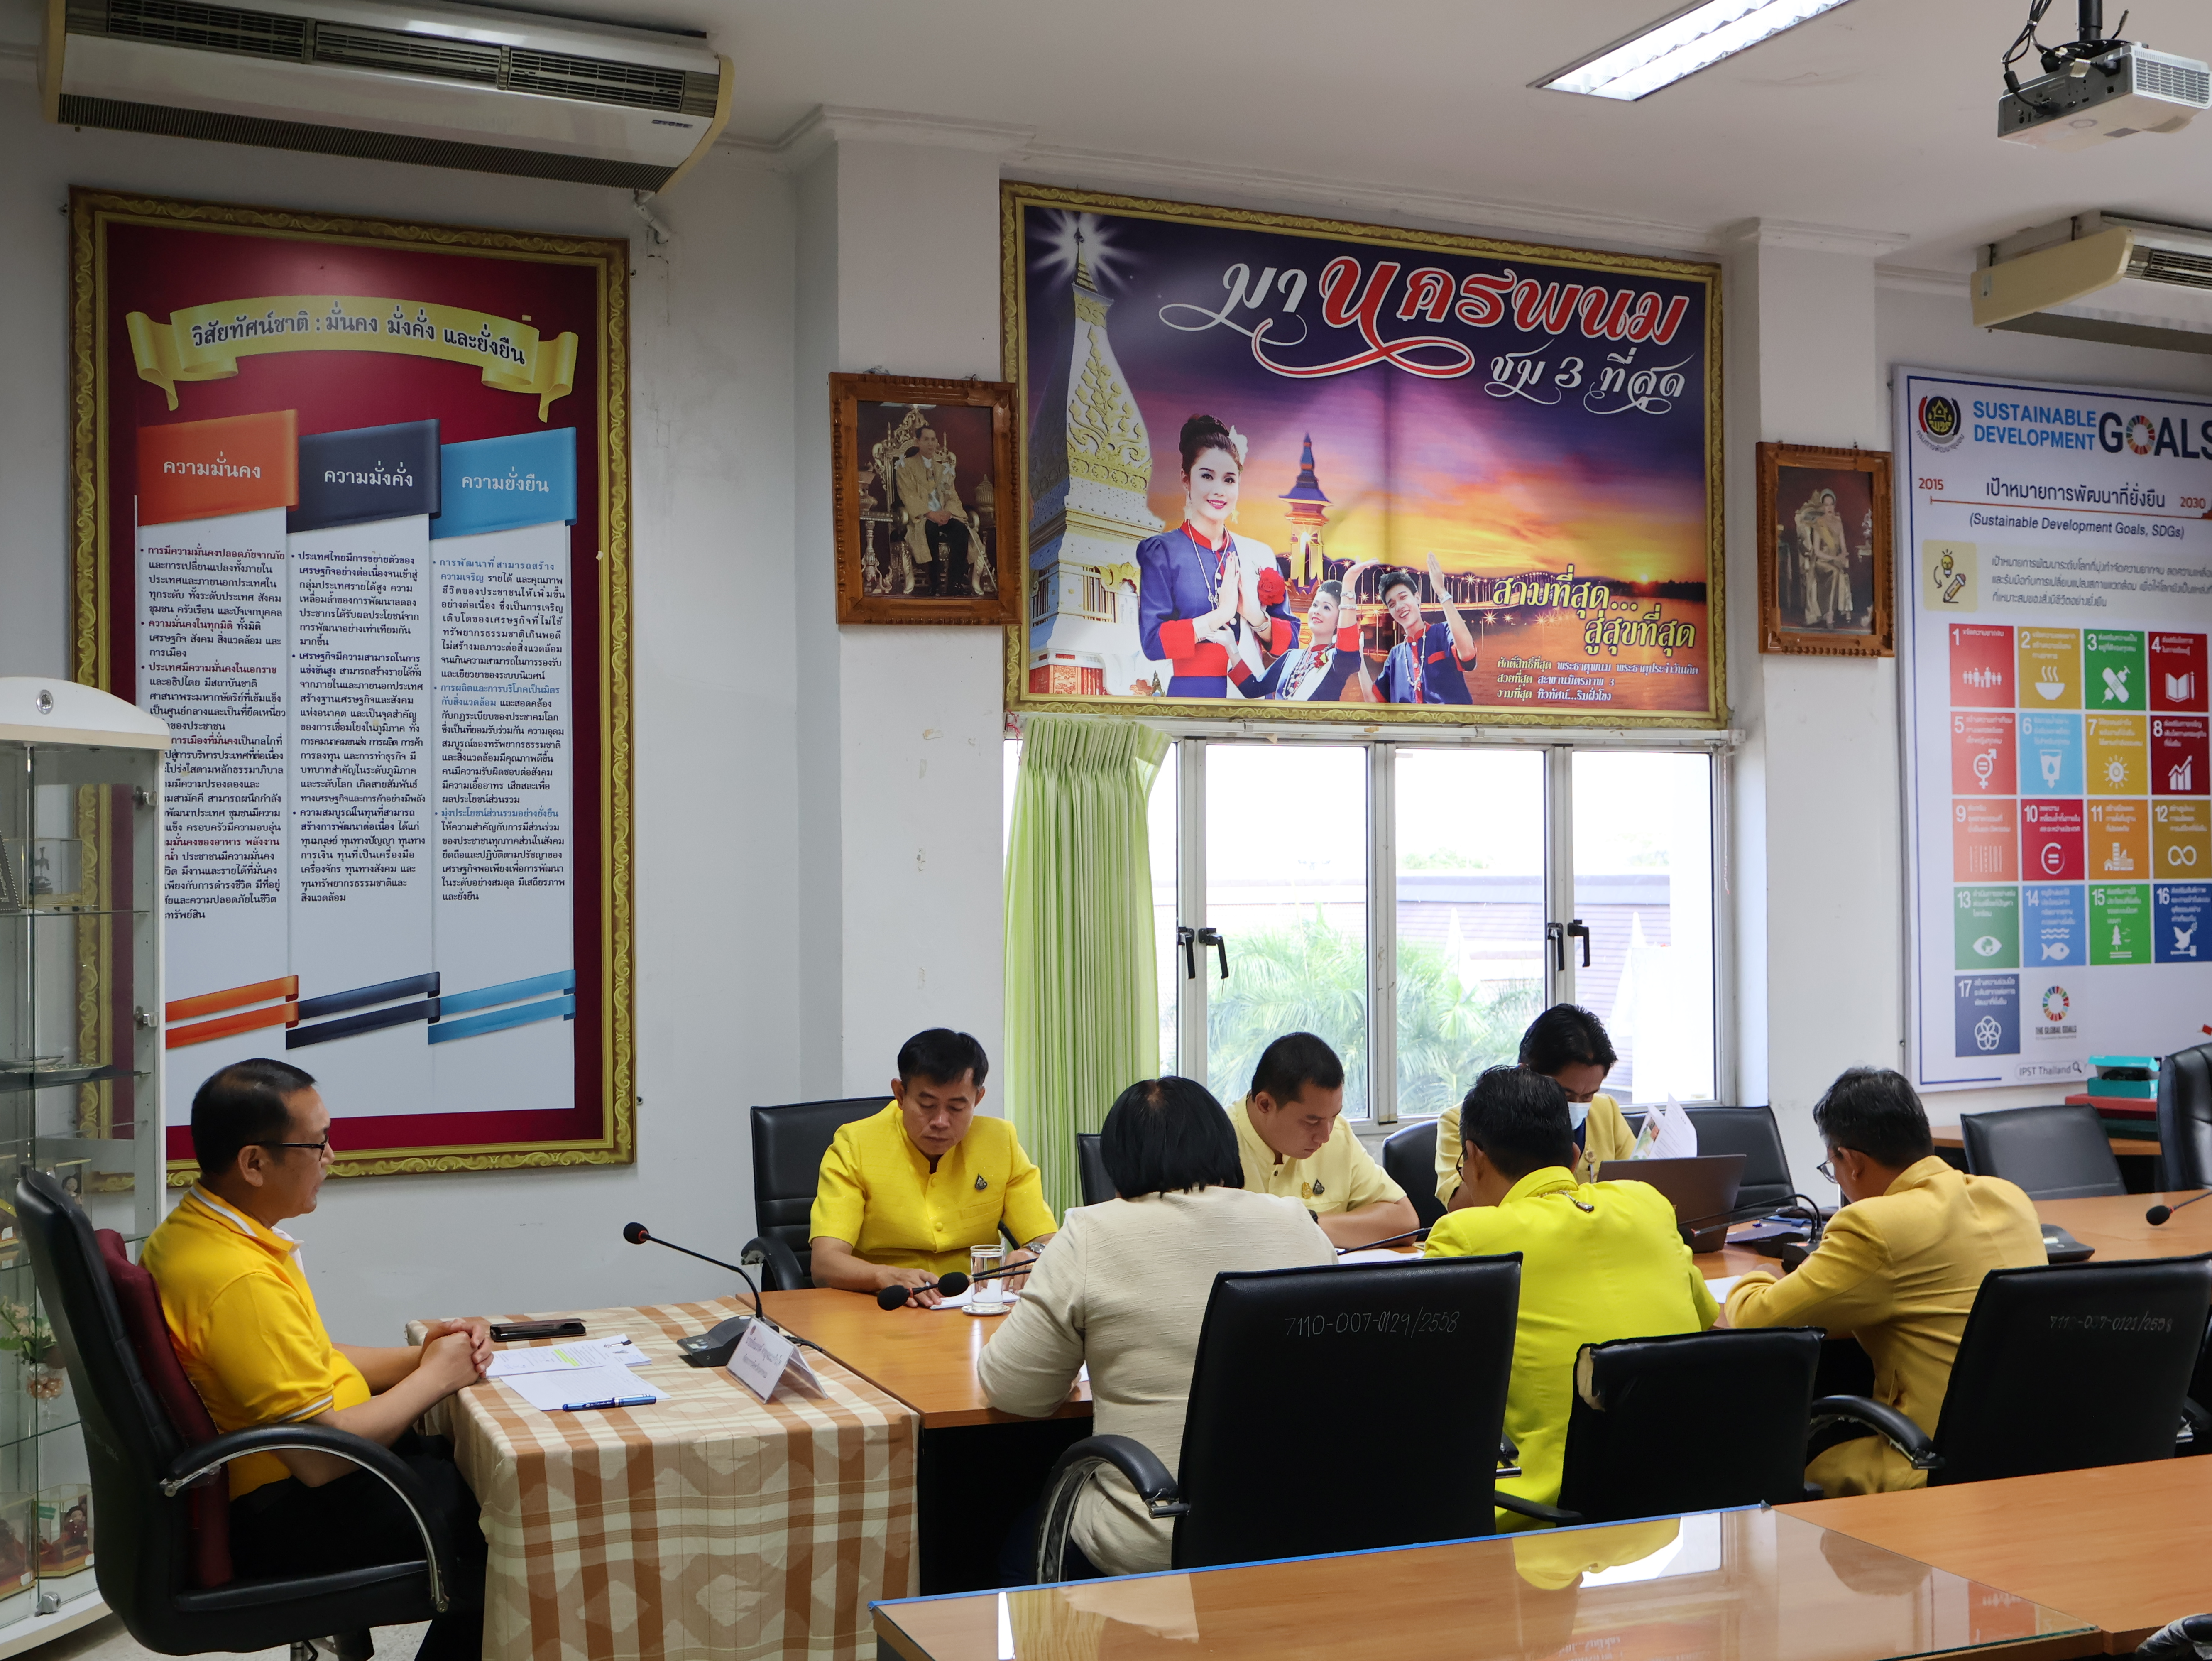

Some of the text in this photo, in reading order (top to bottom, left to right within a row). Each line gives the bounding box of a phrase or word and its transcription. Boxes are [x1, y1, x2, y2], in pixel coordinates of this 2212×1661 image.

[192, 309, 309, 348] วิสัยทัศน์ชาติ
[325, 301, 378, 333] มั่นคง
[387, 306, 436, 342] มั่งคั่ง
[443, 323, 525, 365] และยั่งยืน
[1556, 357, 1583, 388] 3
[1973, 401, 2096, 427] SUSTAINABLE
[1974, 425, 2095, 451] DEVELOPMENT
[163, 451, 261, 479] ความมั่นคง
[324, 460, 413, 487] ความมั่งคั่ง
[461, 466, 549, 493] ความยั่งยืน
[1919, 478, 1944, 490] 2015
[1987, 478, 2165, 508] เป้าหมายการพัฒนาที่ยั่งยืน
[2180, 497, 2206, 509] 2030
[1970, 513, 2184, 539] (Sustainable Development Goals, SDGs)
[441, 572, 563, 587] ความเจริญ รายได้ และคุณภาพ
[149, 589, 184, 601] ทุกระดับ
[258, 593, 281, 603] สังคม
[149, 605, 174, 616] ชุมชน
[177, 604, 214, 615] ครัวเรือน
[236, 617, 261, 630] ทั้งมิติ
[1584, 604, 1696, 657] สู่สุขที่สุด
[149, 632, 187, 645] เศรษฐกิจ
[190, 633, 214, 643] สังคม
[217, 634, 262, 645] สิ่งแวดล้อม
[299, 633, 330, 646] มากขึ้น
[1953, 629, 1960, 646] 1
[2021, 631, 2031, 649] 2
[2087, 634, 2097, 651] 3
[2151, 637, 2161, 653] 4
[149, 647, 187, 657] การเมือง
[300, 664, 336, 678] แข่งขันสูง
[1497, 655, 1552, 672] ศักดิ์สิทธิ์ที่สุด
[1556, 661, 1611, 674] พระธาตุพนม
[149, 675, 201, 687] และอธิปไตย
[1497, 670, 1533, 686] สวยที่สุด
[1537, 674, 1604, 686] สะพานมิตรภาพ
[1497, 685, 1532, 701] งามที่สุด
[500, 698, 552, 708] และสอดคล้อง
[300, 707, 347, 717] แห่งอนาคต
[409, 723, 420, 733] ทั้ง
[1954, 716, 1964, 733] 5
[2022, 718, 2033, 735] 6
[2088, 719, 2097, 735] 7
[2153, 720, 2163, 737] 8
[527, 728, 564, 738] ความอุดม
[369, 737, 399, 746] การผลิต
[401, 736, 423, 747] การค้า
[301, 752, 340, 763] การลงทุน
[409, 750, 416, 760] มี
[301, 777, 352, 788] และระดับโลก
[228, 807, 280, 821] ชุมชนมีความ
[1956, 806, 1967, 823] 9
[2024, 806, 2037, 823] 10
[2091, 806, 2103, 822] 11
[2155, 806, 2168, 822] 12
[397, 820, 419, 830] ได้แก่
[245, 836, 280, 846] พลังงาน
[300, 835, 426, 849] ทุนมนุษย์ ทุนทางปัญญา ทุนทาง
[301, 850, 333, 859] การเงิน
[301, 860, 341, 873] เครื่องจักร
[345, 863, 397, 876] ทุนทางสังคม
[255, 878, 280, 892] มีที่อยู่
[518, 876, 565, 886] มีเสถียรภาพ
[301, 891, 346, 902] สิ่งแวดล้อม
[443, 888, 480, 901] และยั่งยืน
[1958, 891, 1971, 909] 13
[2026, 890, 2039, 907] 14
[2092, 889, 2105, 906] 15
[2158, 888, 2170, 904] 16
[1959, 980, 1972, 997] 17
